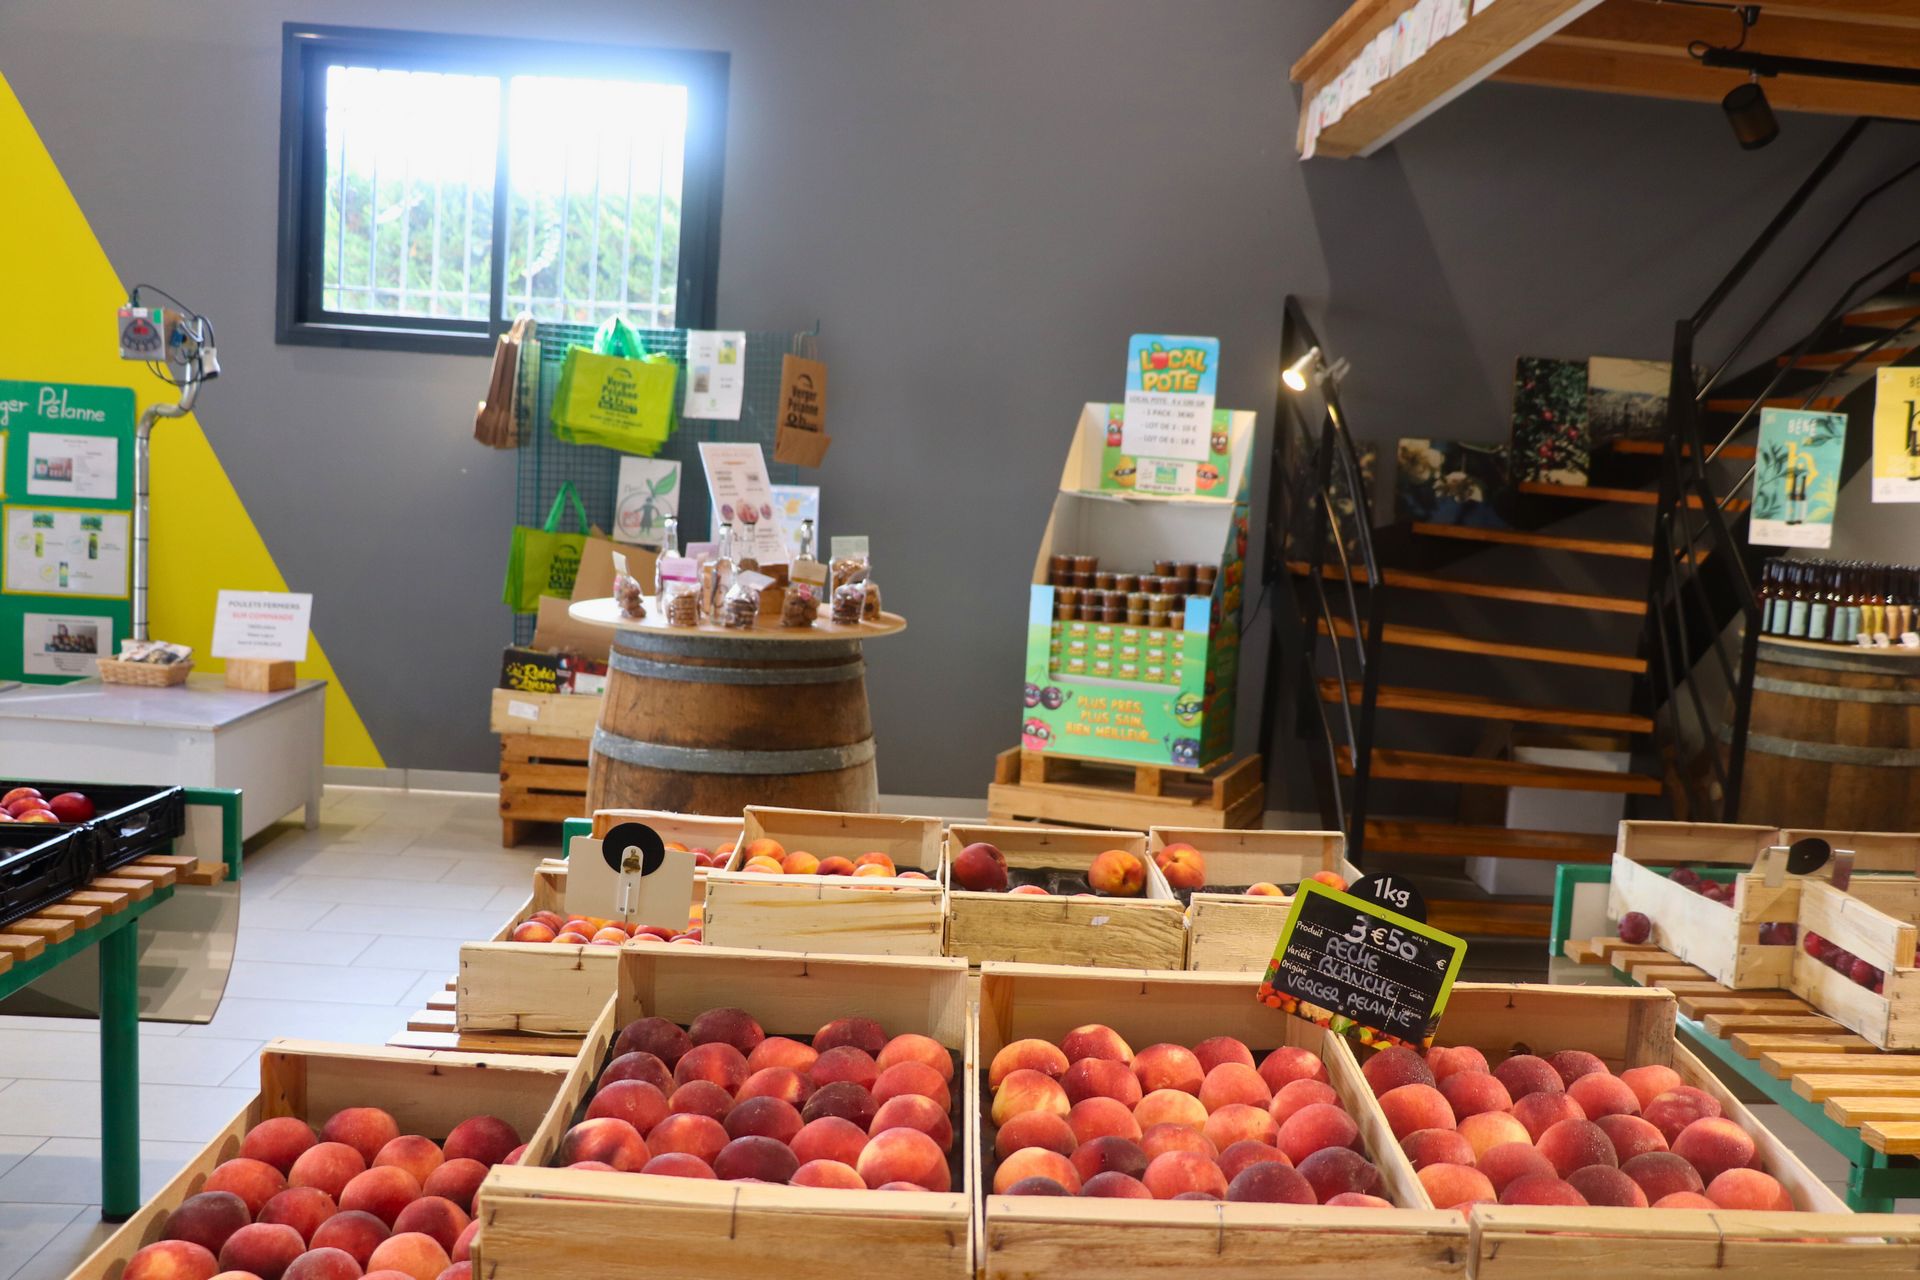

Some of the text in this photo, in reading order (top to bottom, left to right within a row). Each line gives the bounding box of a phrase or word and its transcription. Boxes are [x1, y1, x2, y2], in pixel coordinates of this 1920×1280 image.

[1139, 345, 1207, 373] LOCAL
[1141, 369, 1200, 393] POTE
[38, 386, 106, 422] Pélanne
[1081, 710, 1110, 724] PLUS
[1065, 721, 1092, 736] BIEN
[1296, 920, 1325, 938] Produit
[1287, 944, 1313, 961] Variété
[1281, 959, 1308, 976] Origine
[1436, 958, 1448, 971] €
[1318, 956, 1398, 1001] BLANCHE
[1287, 974, 1411, 1028] VERGER PELANNE
